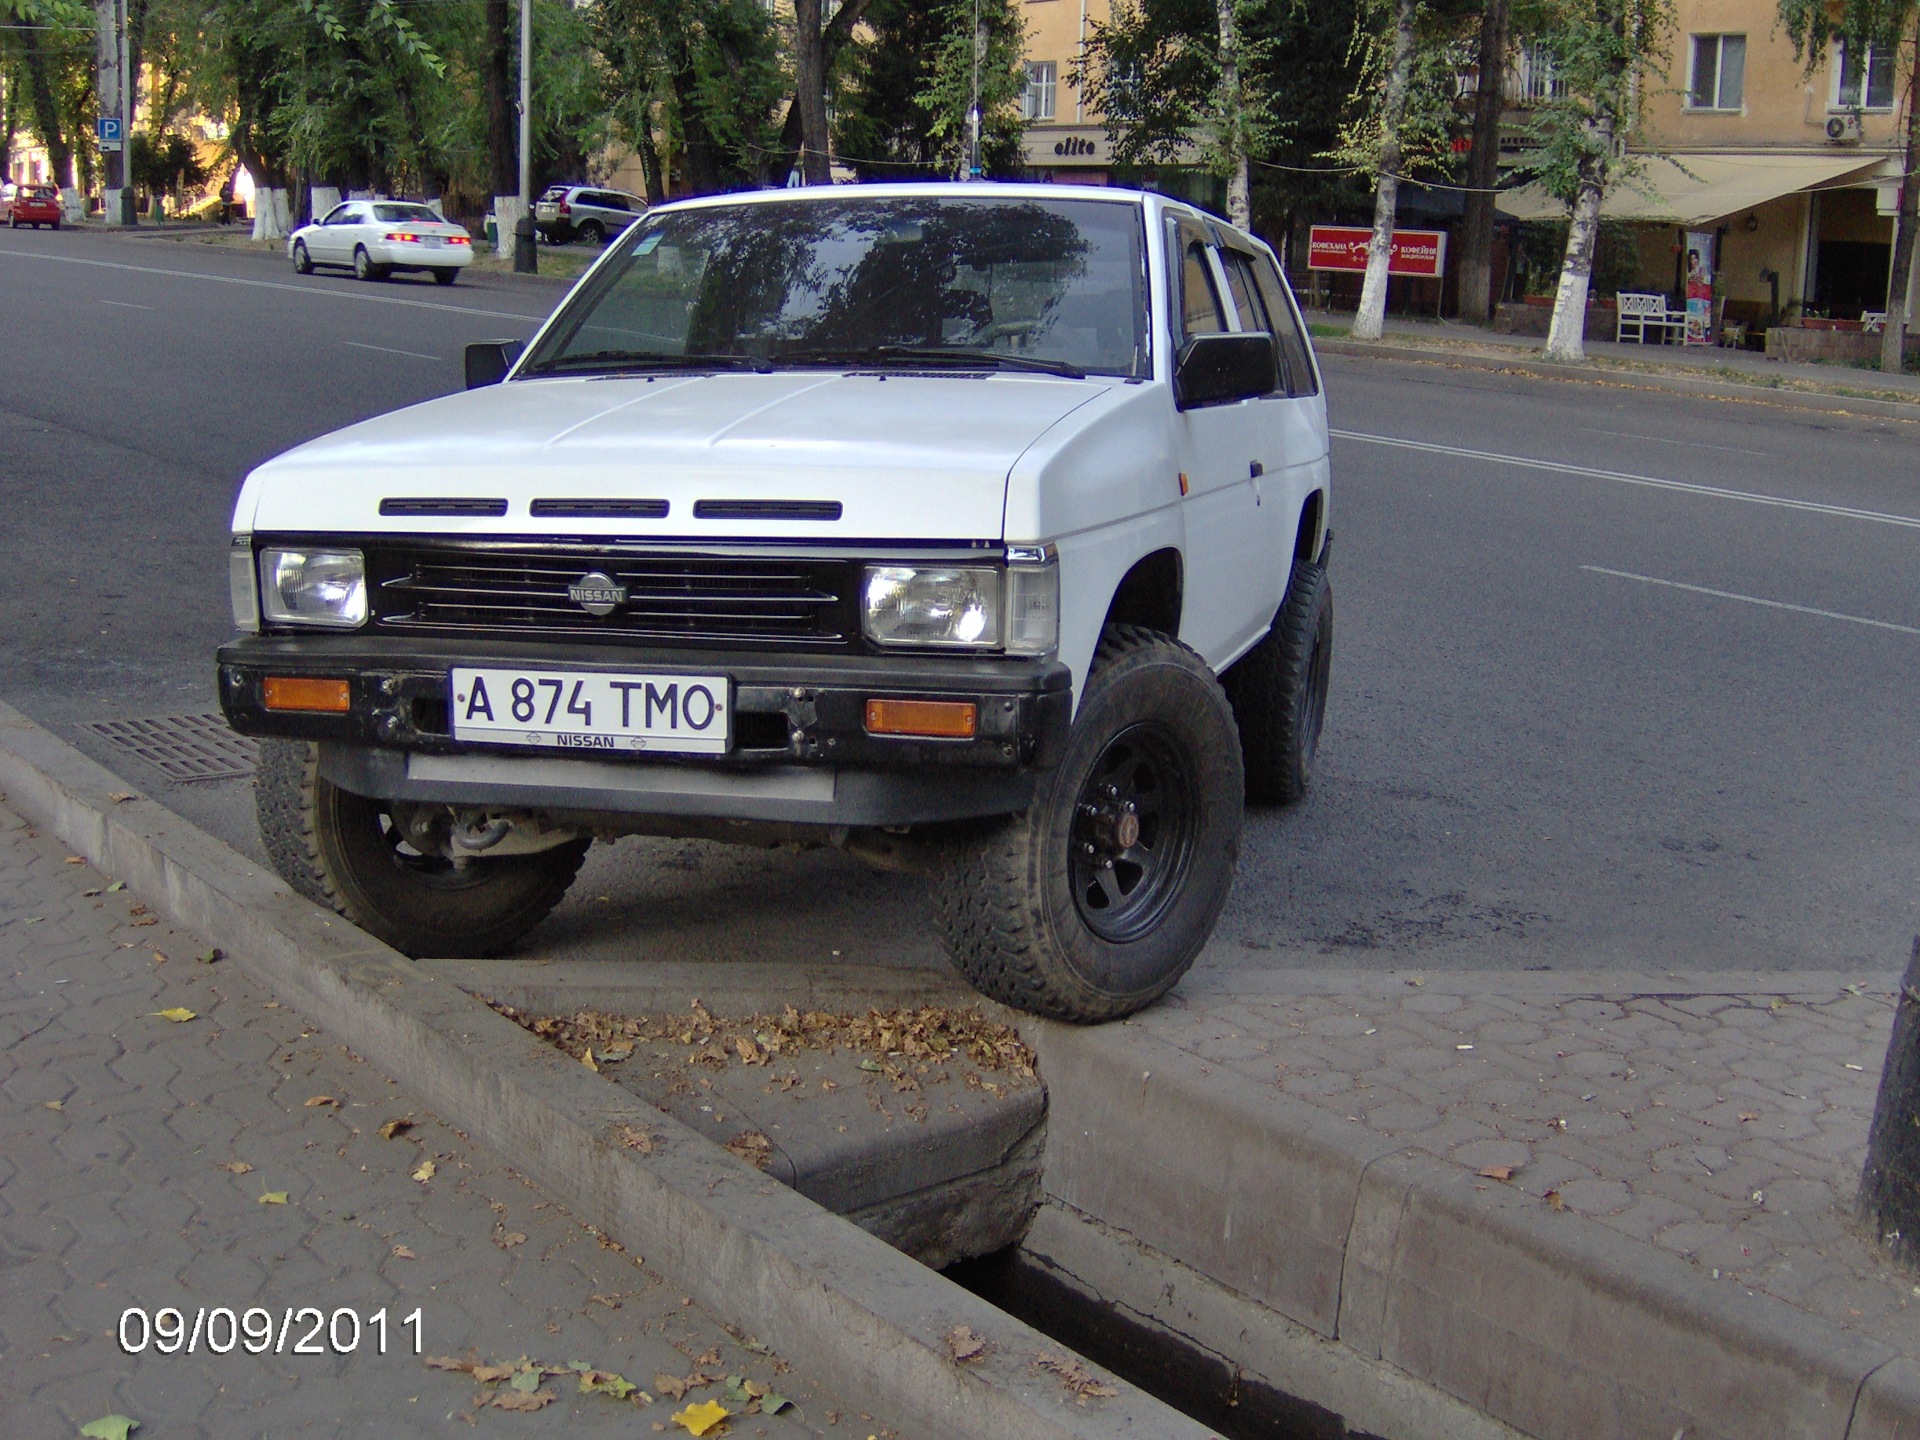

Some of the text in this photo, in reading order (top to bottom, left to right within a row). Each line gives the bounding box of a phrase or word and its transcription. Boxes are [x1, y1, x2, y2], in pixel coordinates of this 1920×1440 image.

[105, 121, 117, 138] P
[1055, 137, 1095, 156] elite
[1401, 245, 1437, 255] КОФЕЙНЯ
[569, 588, 623, 602] NISSAN
[465, 676, 715, 731] A 874 TMO
[557, 734, 614, 748] NISSAN
